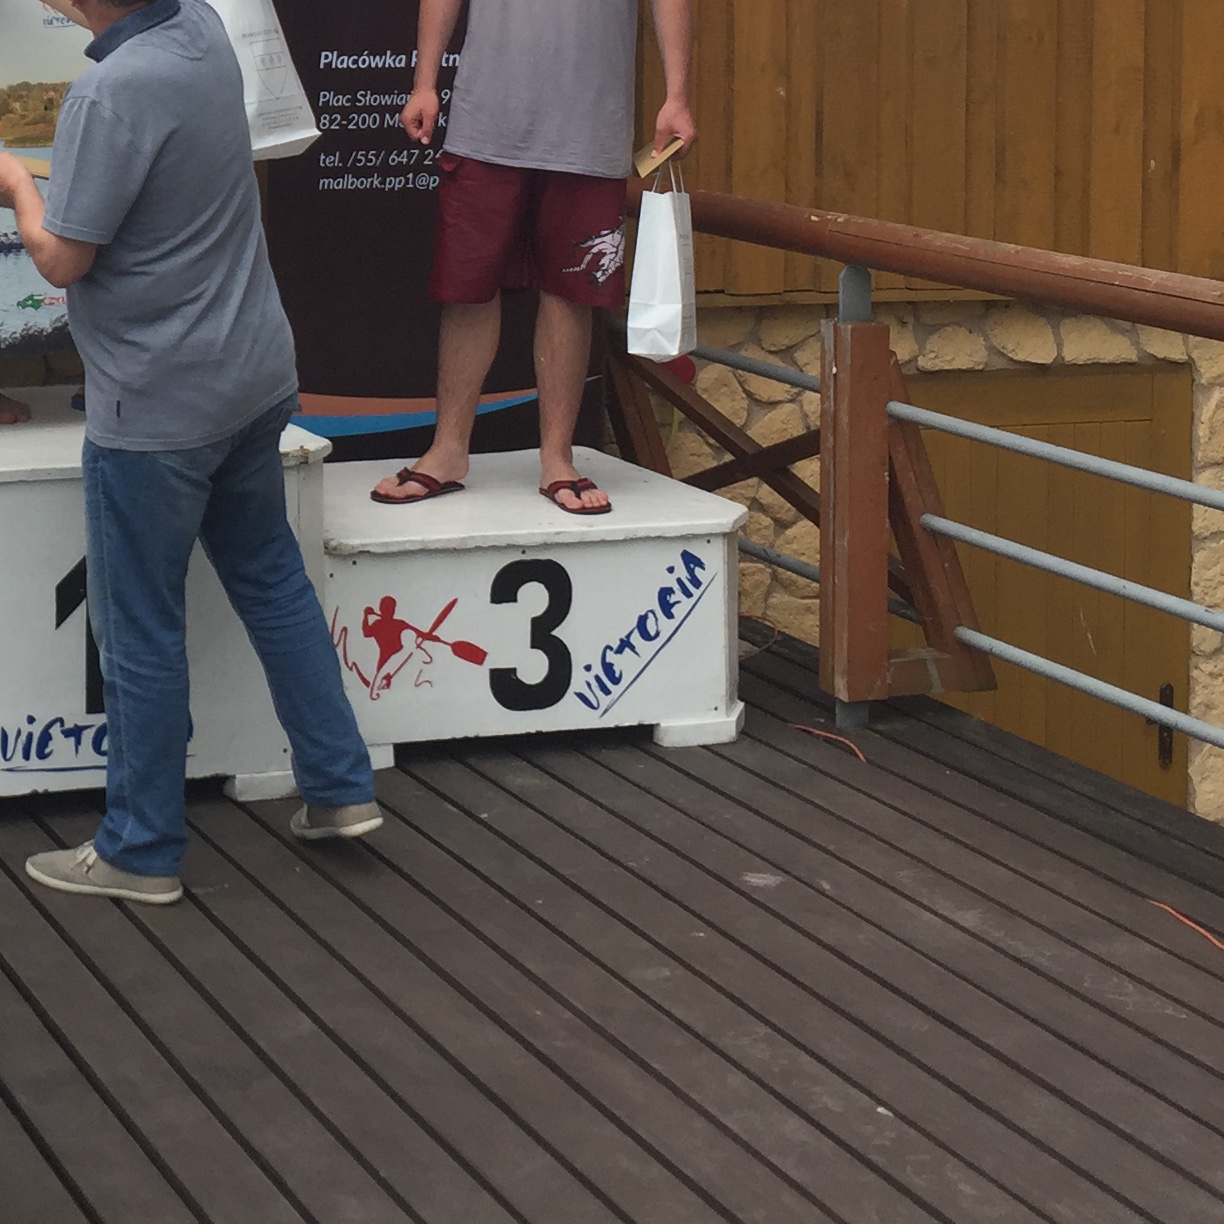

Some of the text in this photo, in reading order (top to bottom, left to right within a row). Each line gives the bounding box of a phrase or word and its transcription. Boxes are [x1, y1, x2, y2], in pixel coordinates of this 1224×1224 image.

[319, 49, 406, 69] Placówka
[318, 90, 352, 107] Plac
[319, 113, 380, 130] 82-200
[319, 151, 343, 167] tel.
[346, 150, 385, 167] /55/
[388, 149, 420, 166] 647
[488, 557, 573, 712] 3
